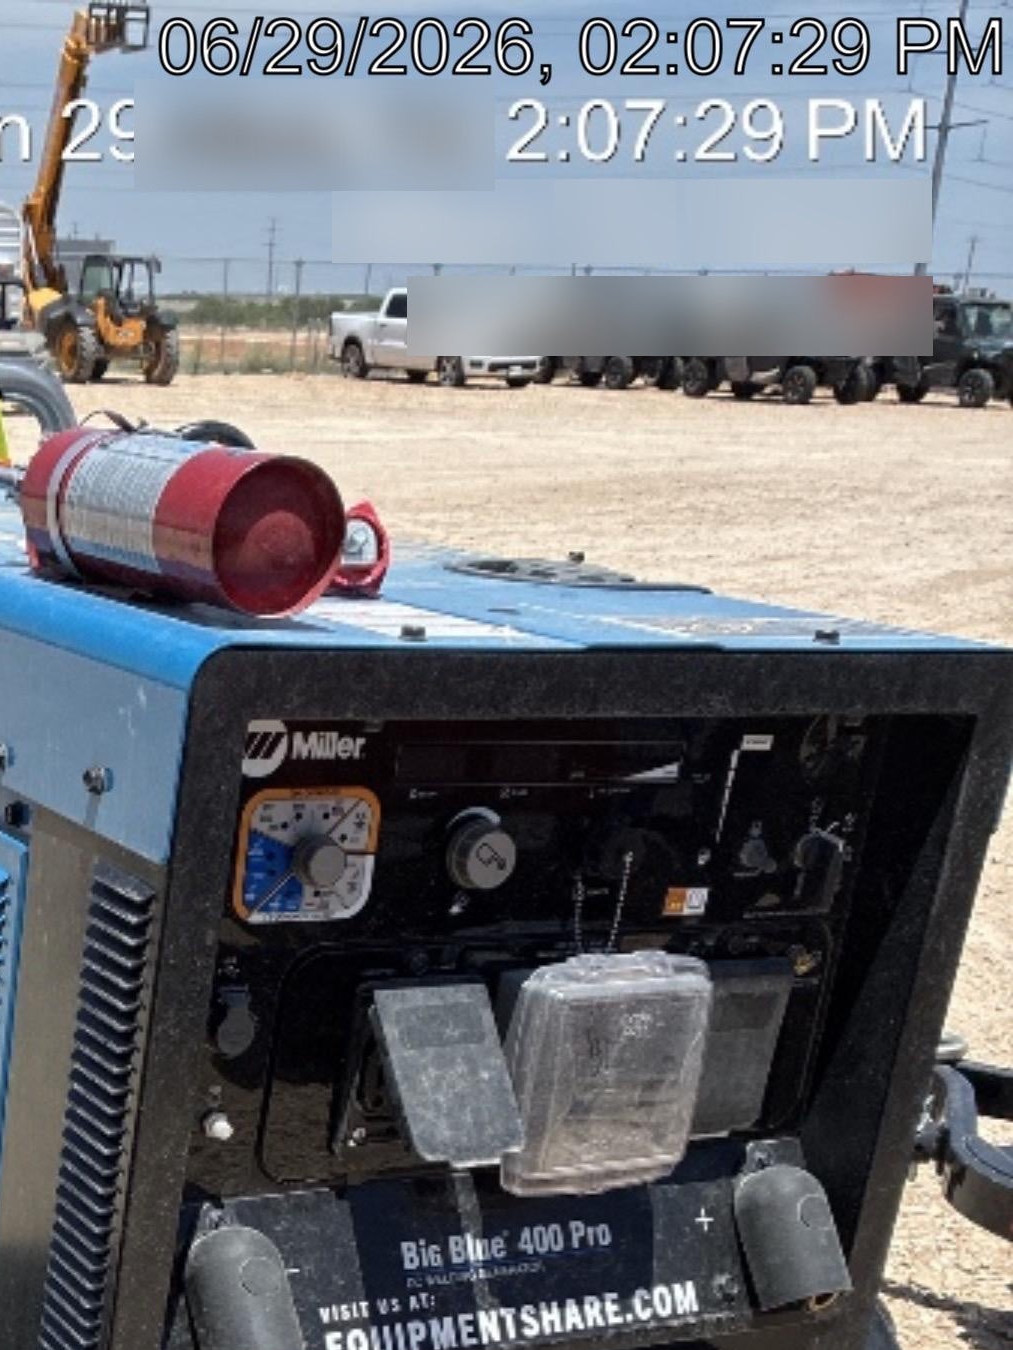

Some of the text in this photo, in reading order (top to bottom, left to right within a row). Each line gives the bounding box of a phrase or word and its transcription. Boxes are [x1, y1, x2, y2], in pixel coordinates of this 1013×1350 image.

[290, 730, 366, 761] Miller
[517, 1223, 564, 1255] 400
[569, 1220, 612, 1249] Pro
[319, 1292, 436, 1325] VISIT US AT:
